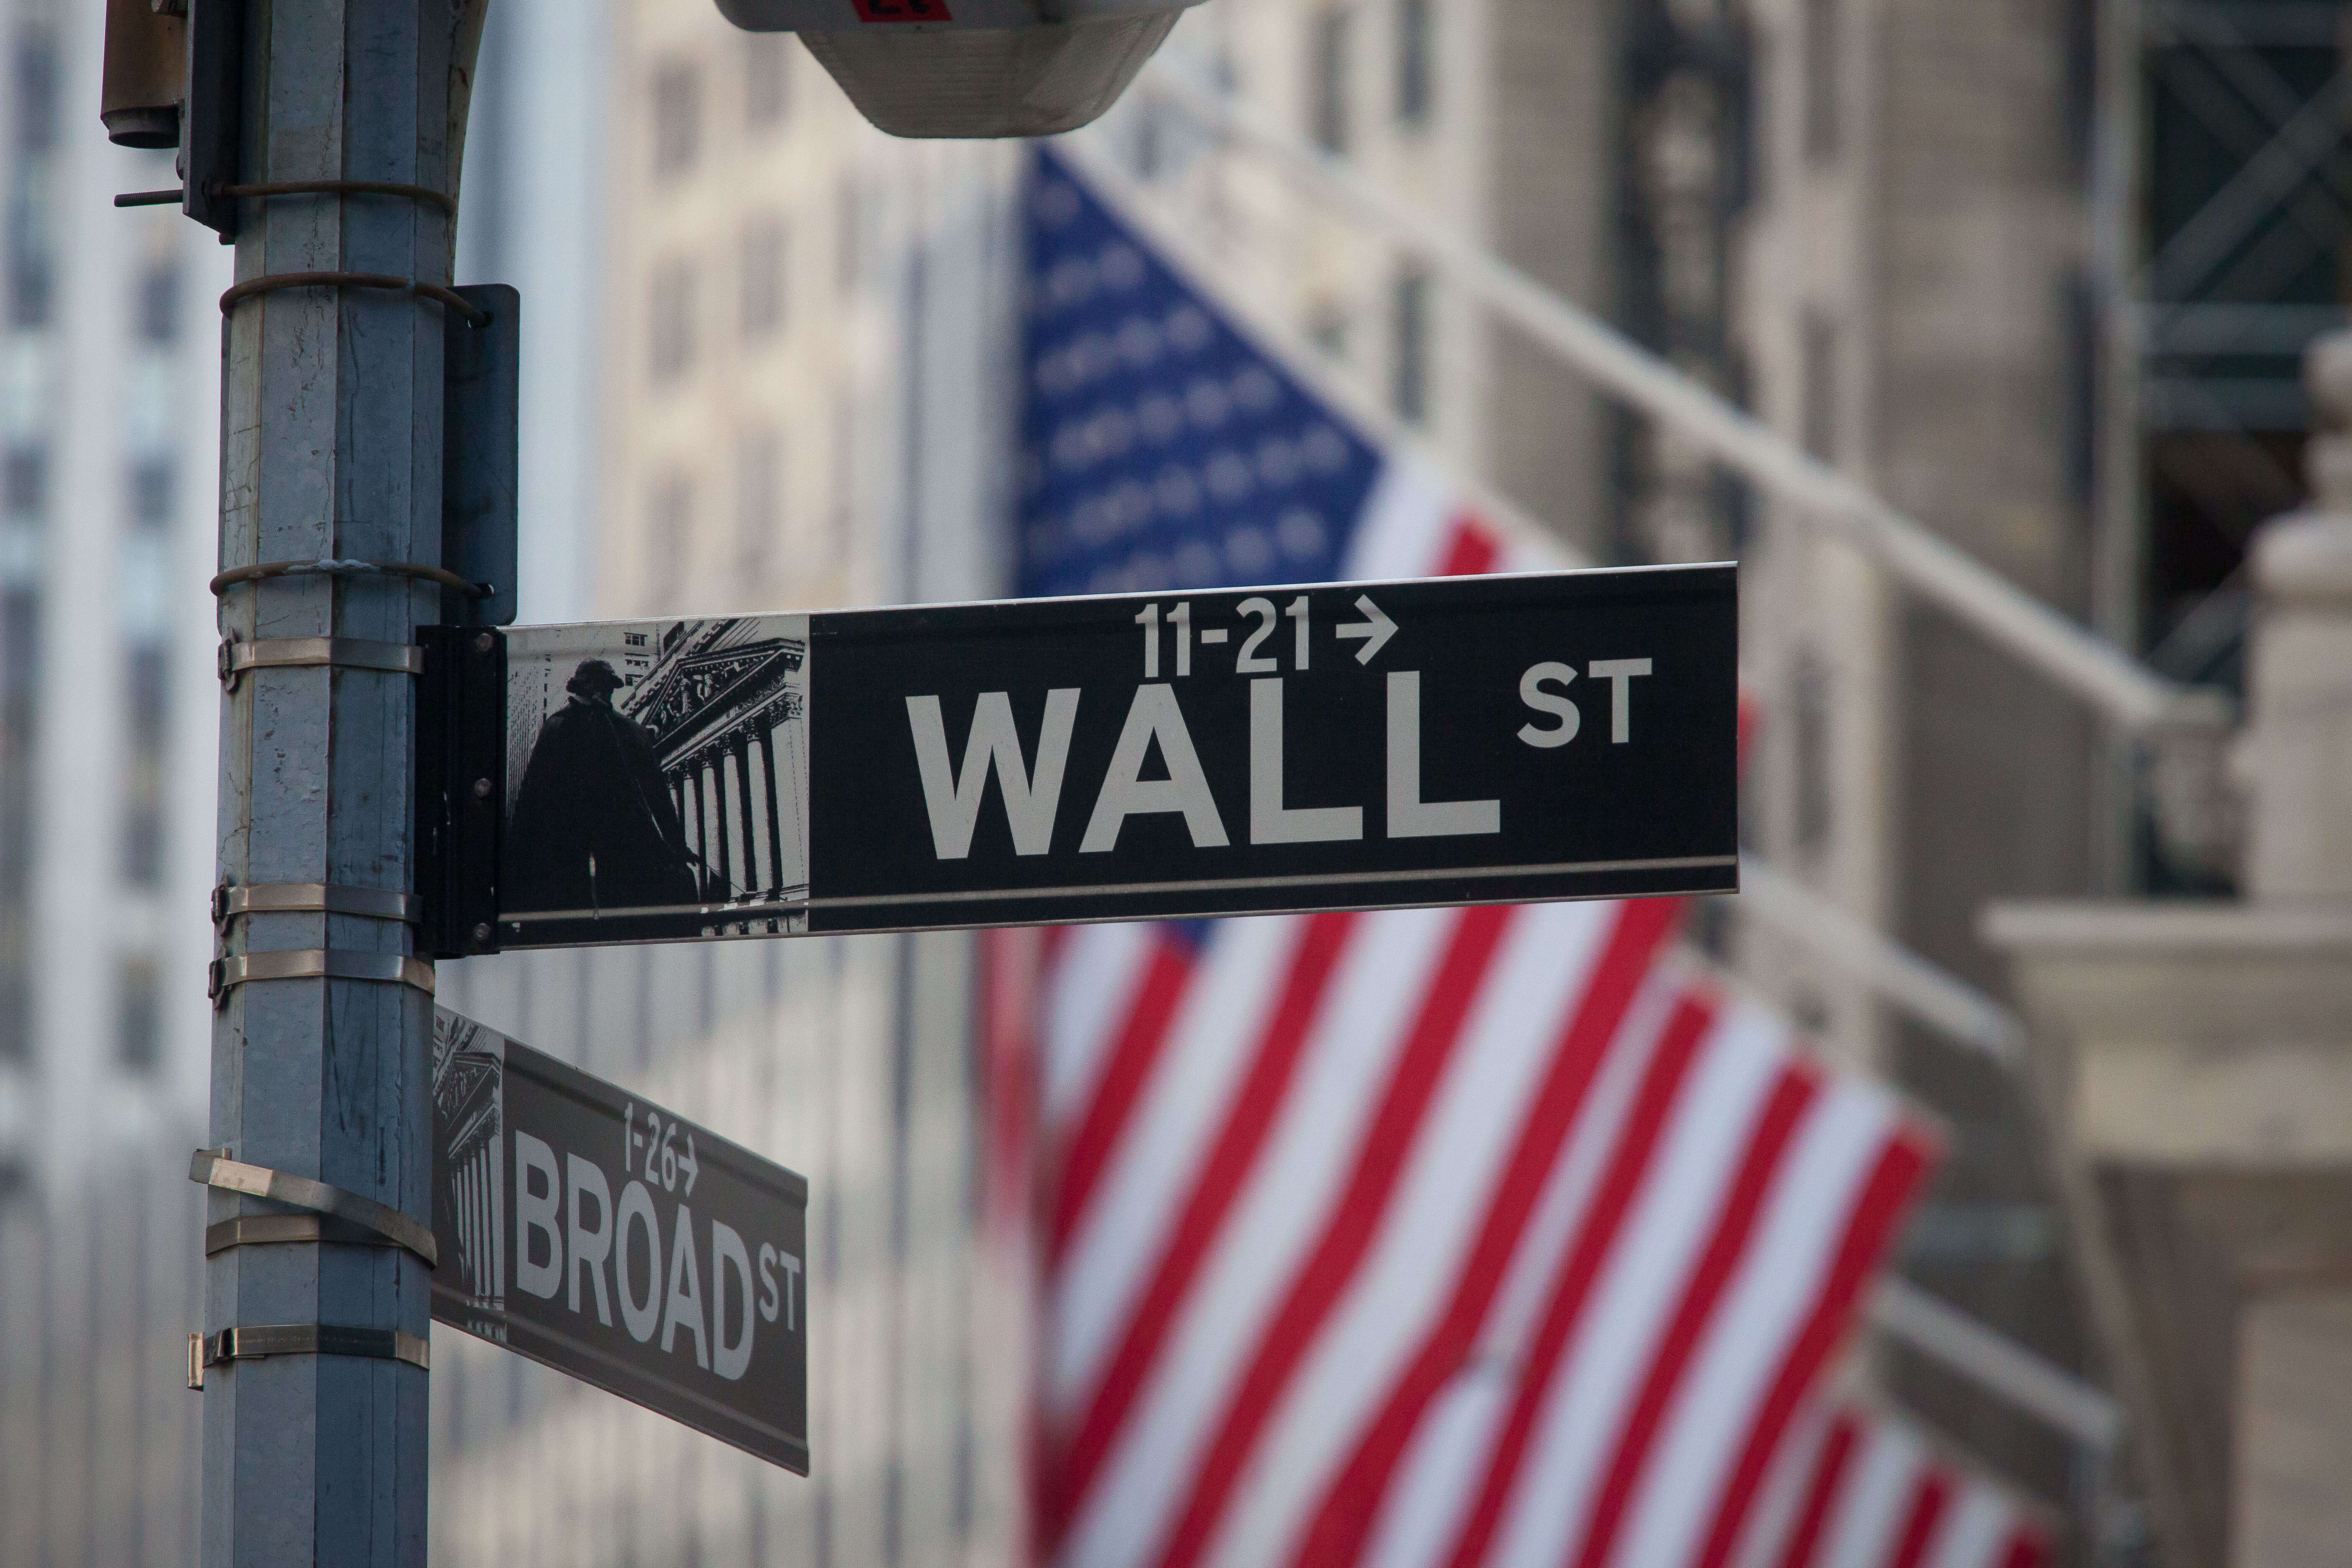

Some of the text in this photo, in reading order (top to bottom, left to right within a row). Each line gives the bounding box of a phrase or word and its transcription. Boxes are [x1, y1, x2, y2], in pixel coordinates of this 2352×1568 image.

[1135, 596, 1309, 678] 11-21
[905, 658, 1652, 859] WALL ST
[624, 1101, 677, 1193] 1-26
[515, 1130, 801, 1380] BROAD ST
